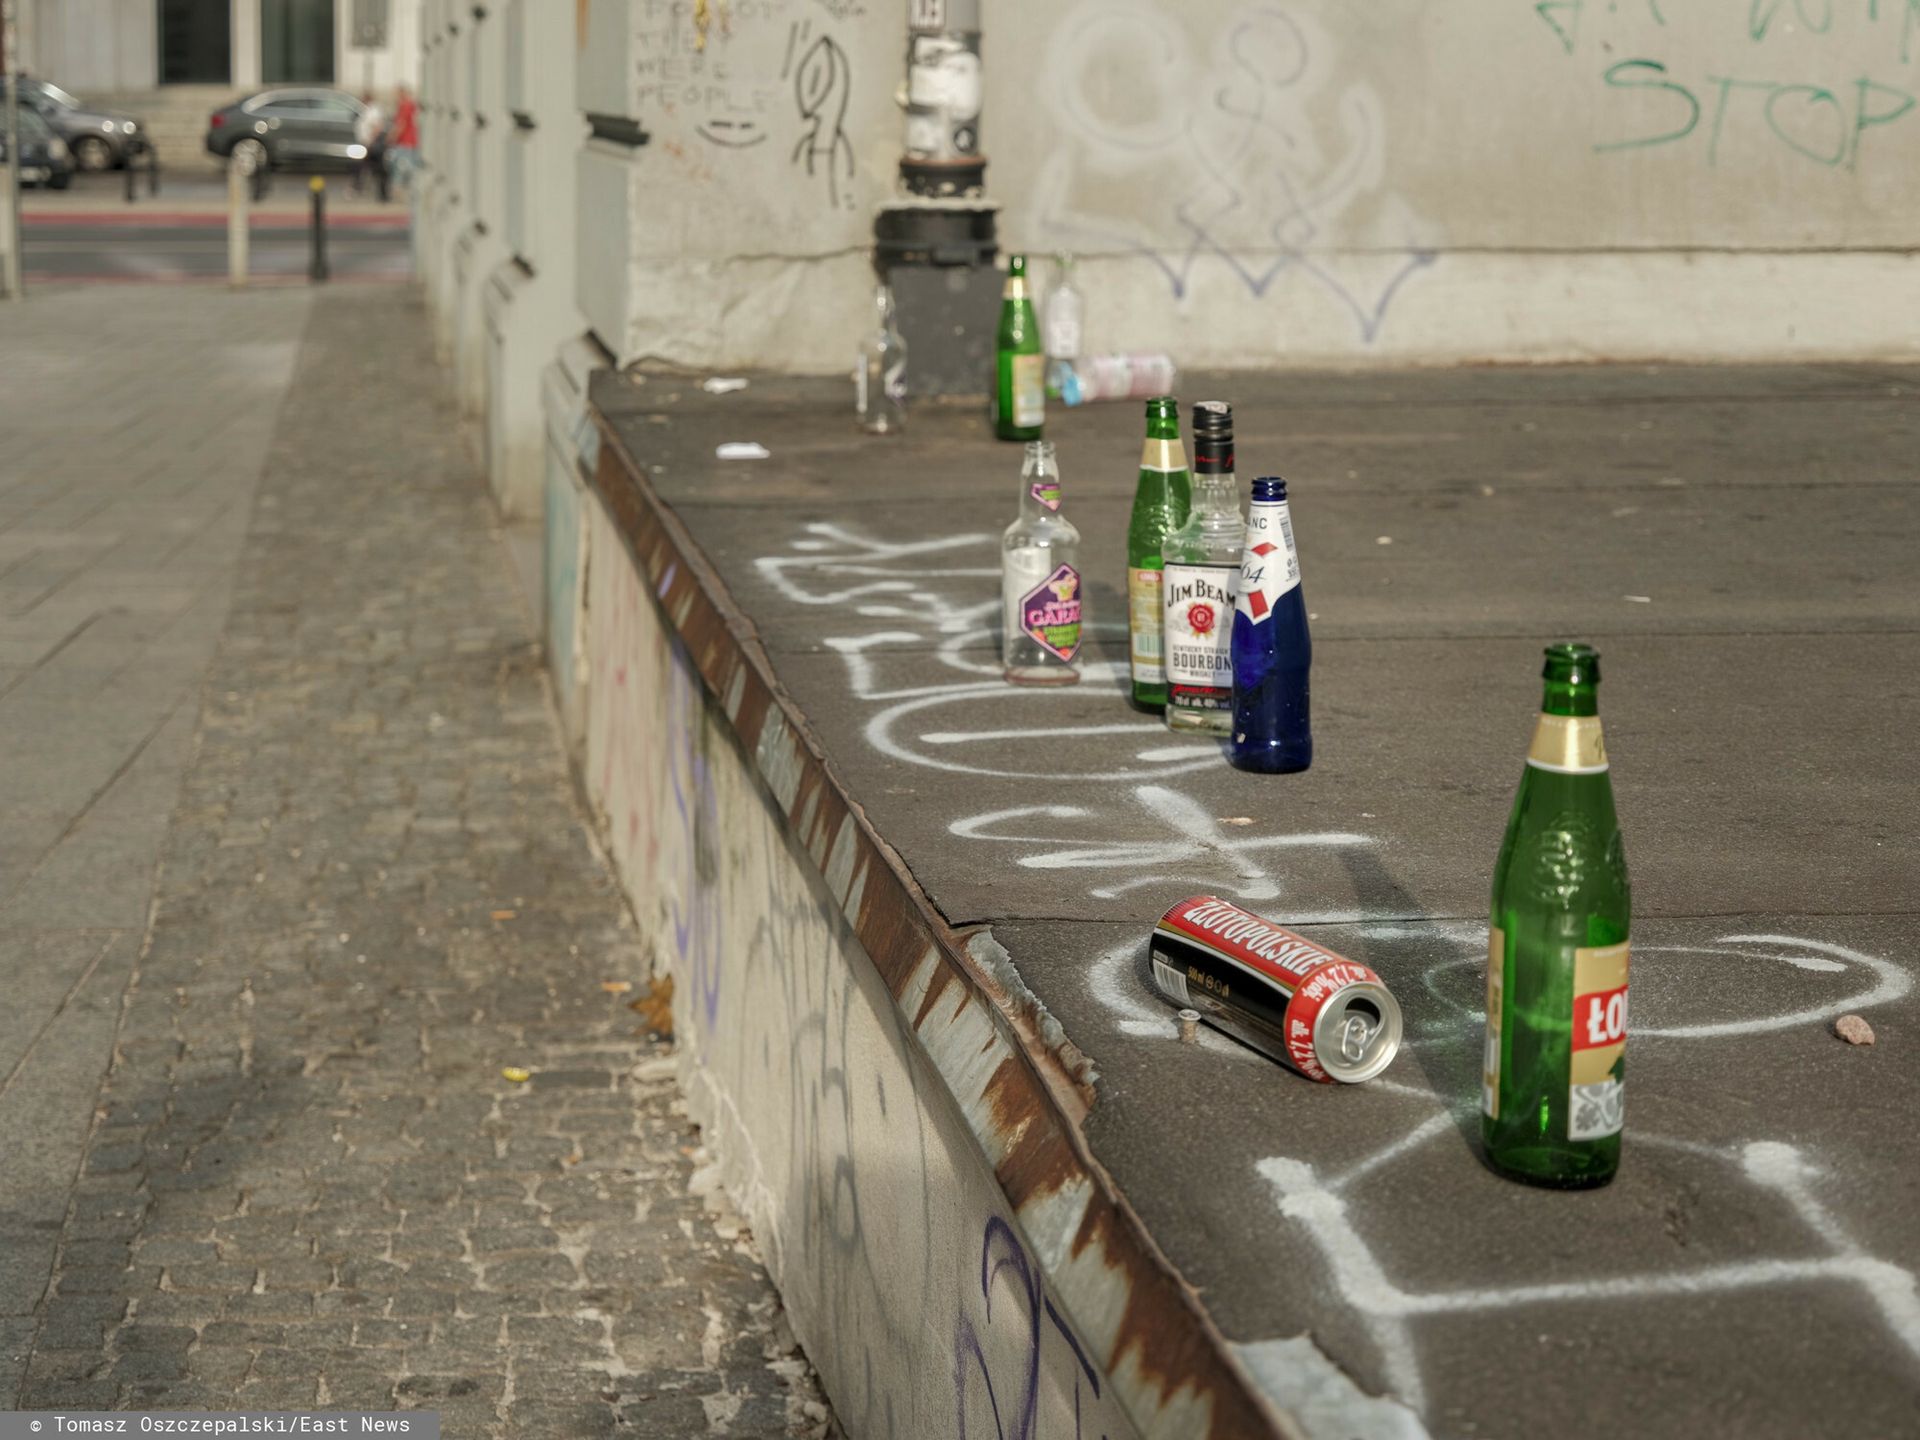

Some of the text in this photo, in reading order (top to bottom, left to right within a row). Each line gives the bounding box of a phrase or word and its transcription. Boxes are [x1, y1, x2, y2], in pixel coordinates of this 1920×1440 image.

[636, 56, 731, 80] WERE
[636, 83, 774, 113] PEOPLE
[1592, 58, 1917, 175] STOP
[1168, 583, 1193, 608] JIM
[1196, 579, 1236, 610] BEAM
[1173, 652, 1231, 671] BOURBON
[1182, 901, 1334, 977] ZŁOTOPOLSKIE
